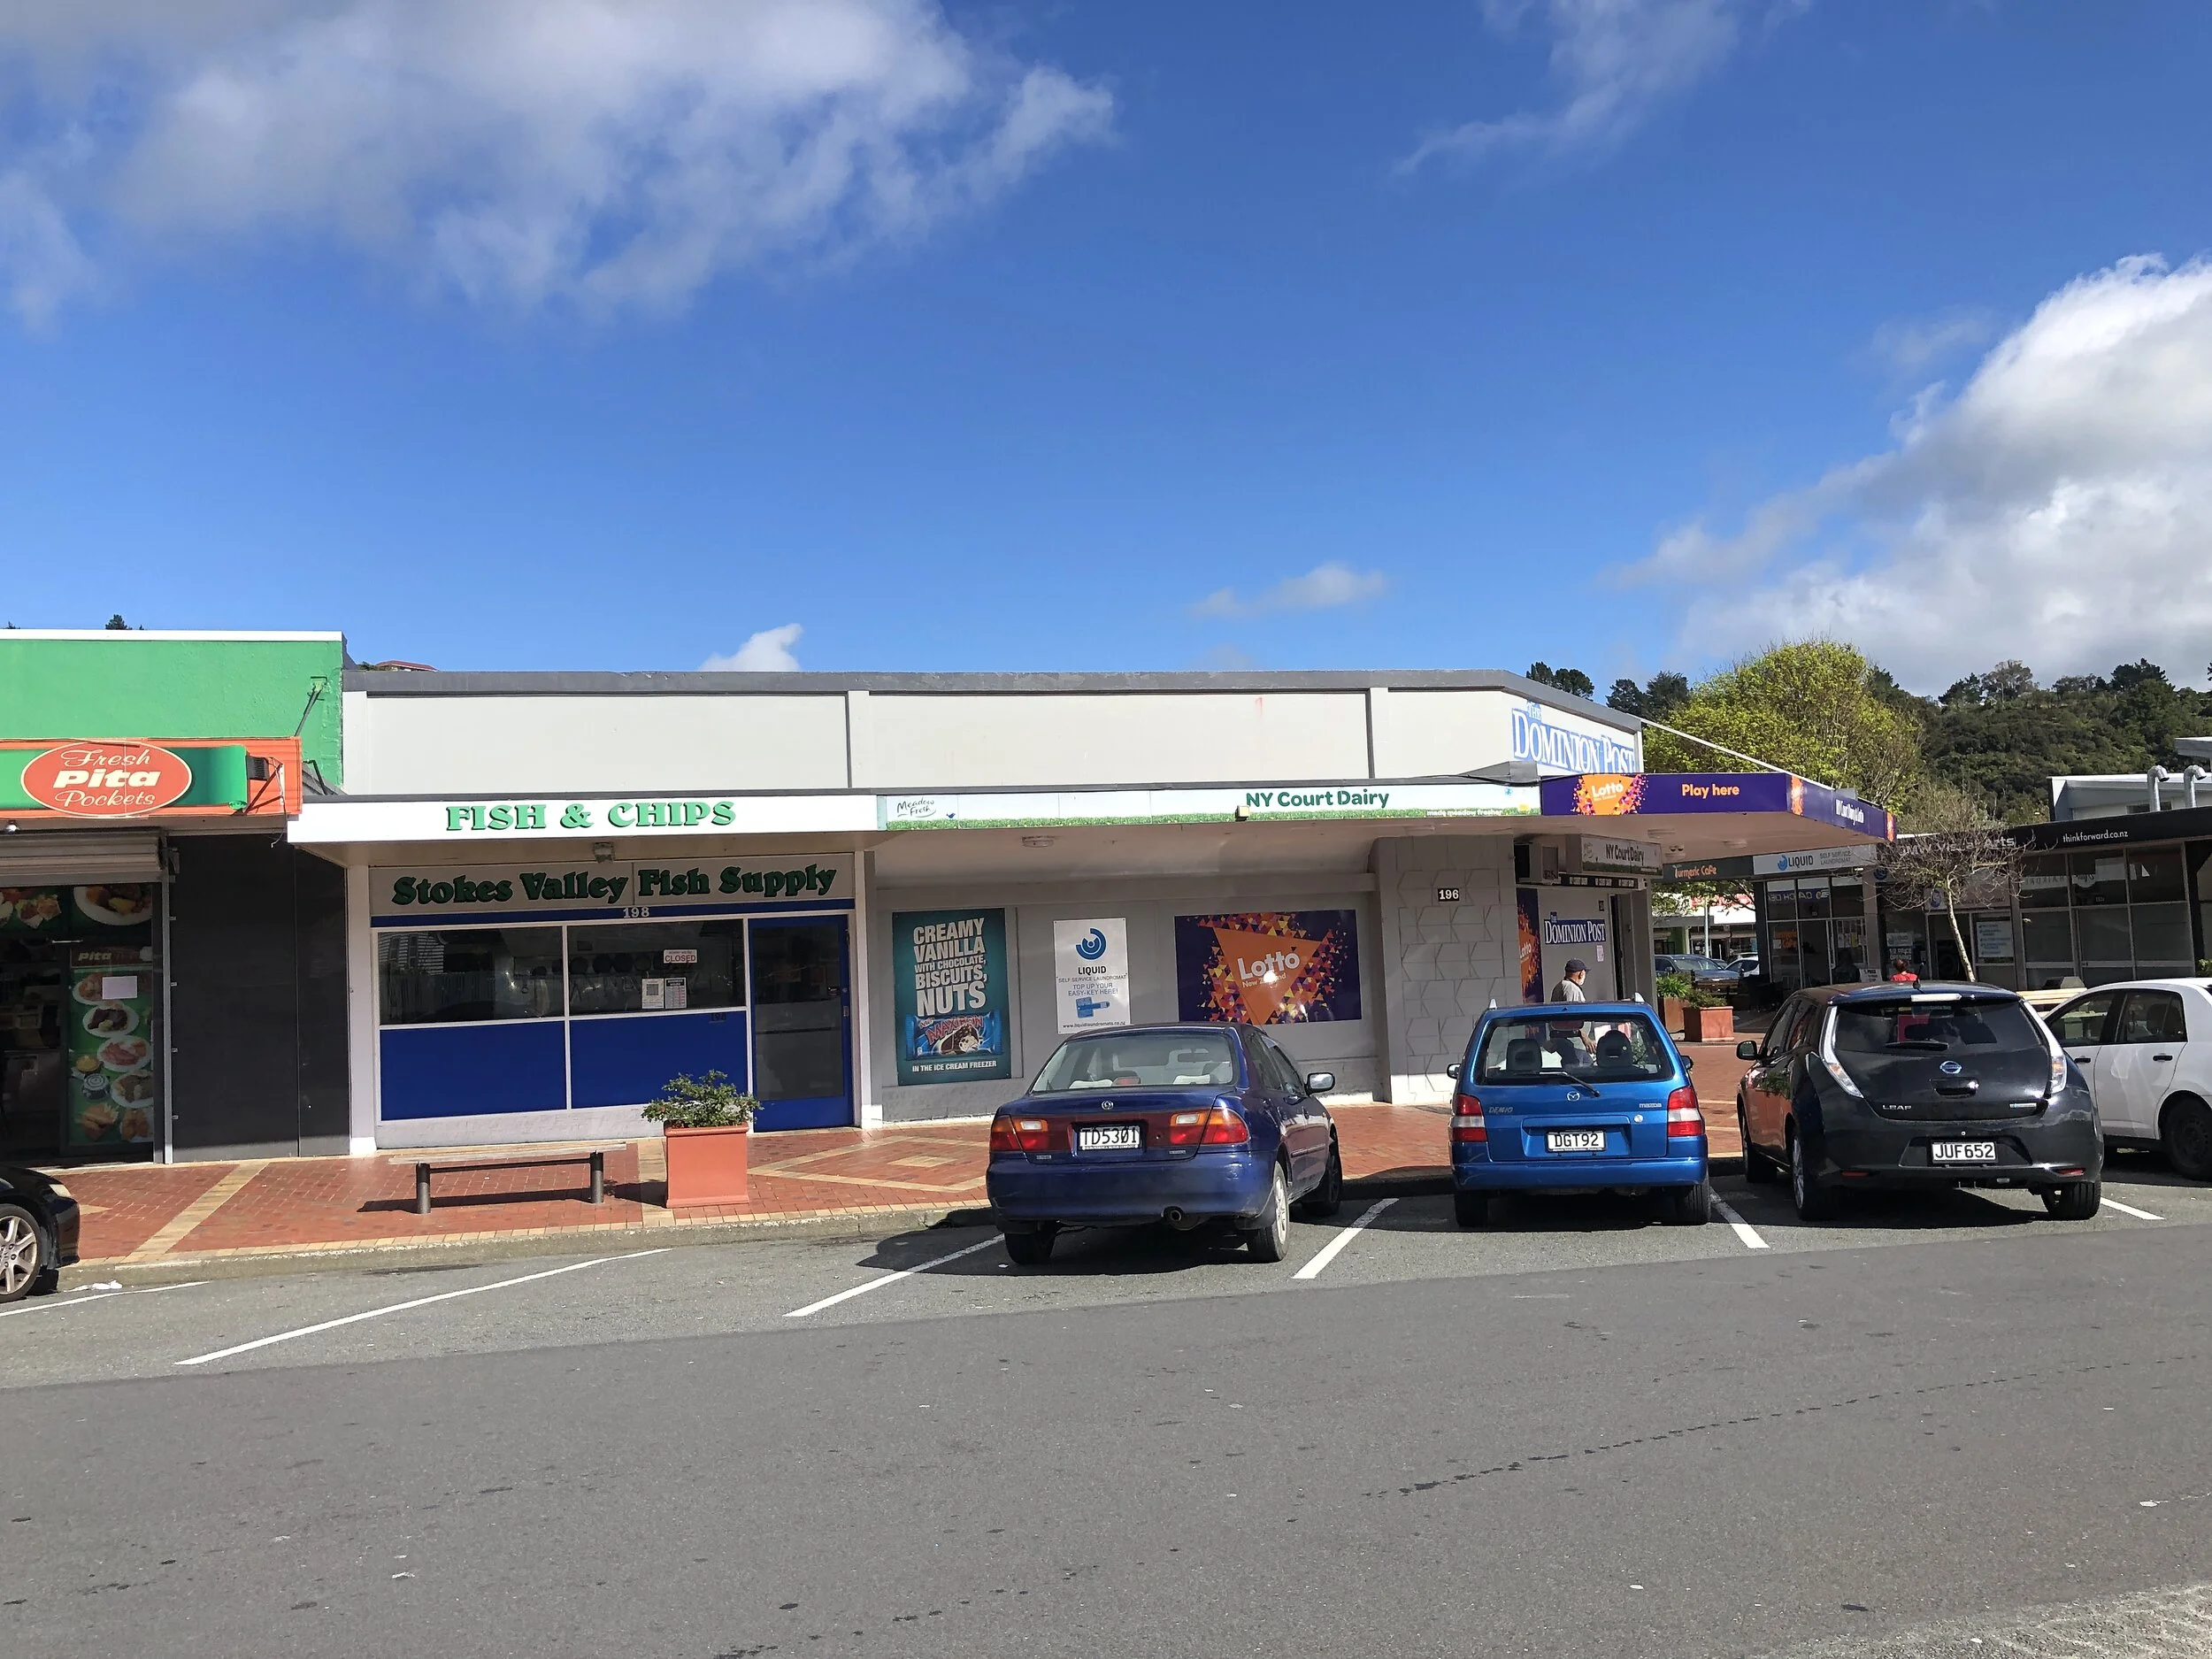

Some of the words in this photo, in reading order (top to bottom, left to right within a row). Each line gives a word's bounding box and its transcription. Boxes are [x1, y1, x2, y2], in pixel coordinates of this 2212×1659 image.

[1512, 709, 1601, 773] DOMINION
[1601, 735, 1636, 773] POST
[60, 749, 150, 767] Fresh
[53, 768, 162, 788] Pita
[54, 789, 156, 807] Pockets
[1246, 792, 1274, 807] NY
[1277, 791, 1333, 807] Court
[1337, 788, 1390, 809] Dairy
[1591, 782, 1624, 797] Lotto
[1681, 784, 1709, 799] Play
[1712, 784, 1740, 796] here
[896, 797, 935, 813] Meadow
[910, 805, 932, 816] Fresh
[445, 803, 547, 831] FISH
[559, 803, 595, 828] &
[607, 801, 737, 828] CHIPS
[2062, 829, 2129, 843] thinkforward.co.nz
[1605, 844, 1614, 859] NY
[1614, 845, 1631, 862] Court
[1630, 846, 1645, 866] Dairy
[1788, 855, 1814, 868] LIQUID
[391, 874, 513, 906] Stokes
[519, 871, 629, 904] Valley
[638, 867, 711, 897] Fish
[718, 864, 837, 898] Supply
[1439, 889, 1459, 900] 196
[622, 907, 650, 918] 198
[913, 918, 985, 945] CREAMY
[1544, 920, 1587, 944] DOMINION
[1586, 920, 1605, 942] POST
[913, 935, 986, 963] VANILLA
[914, 961, 935, 973] WITH
[937, 955, 987, 970] CHOCOLATE,
[1078, 965, 1107, 976] LIQUID
[1237, 951, 1300, 979] Lotto
[915, 964, 987, 990] BISCUITS,
[917, 980, 987, 1017] NUTS
[945, 1062, 969, 1071] CREAM
[970, 1060, 997, 1070] FREEZER
[1081, 1125, 1138, 1145] TD5301
[1555, 1133, 1599, 1147] DGT92
[1935, 1144, 1994, 1159] JUF652
